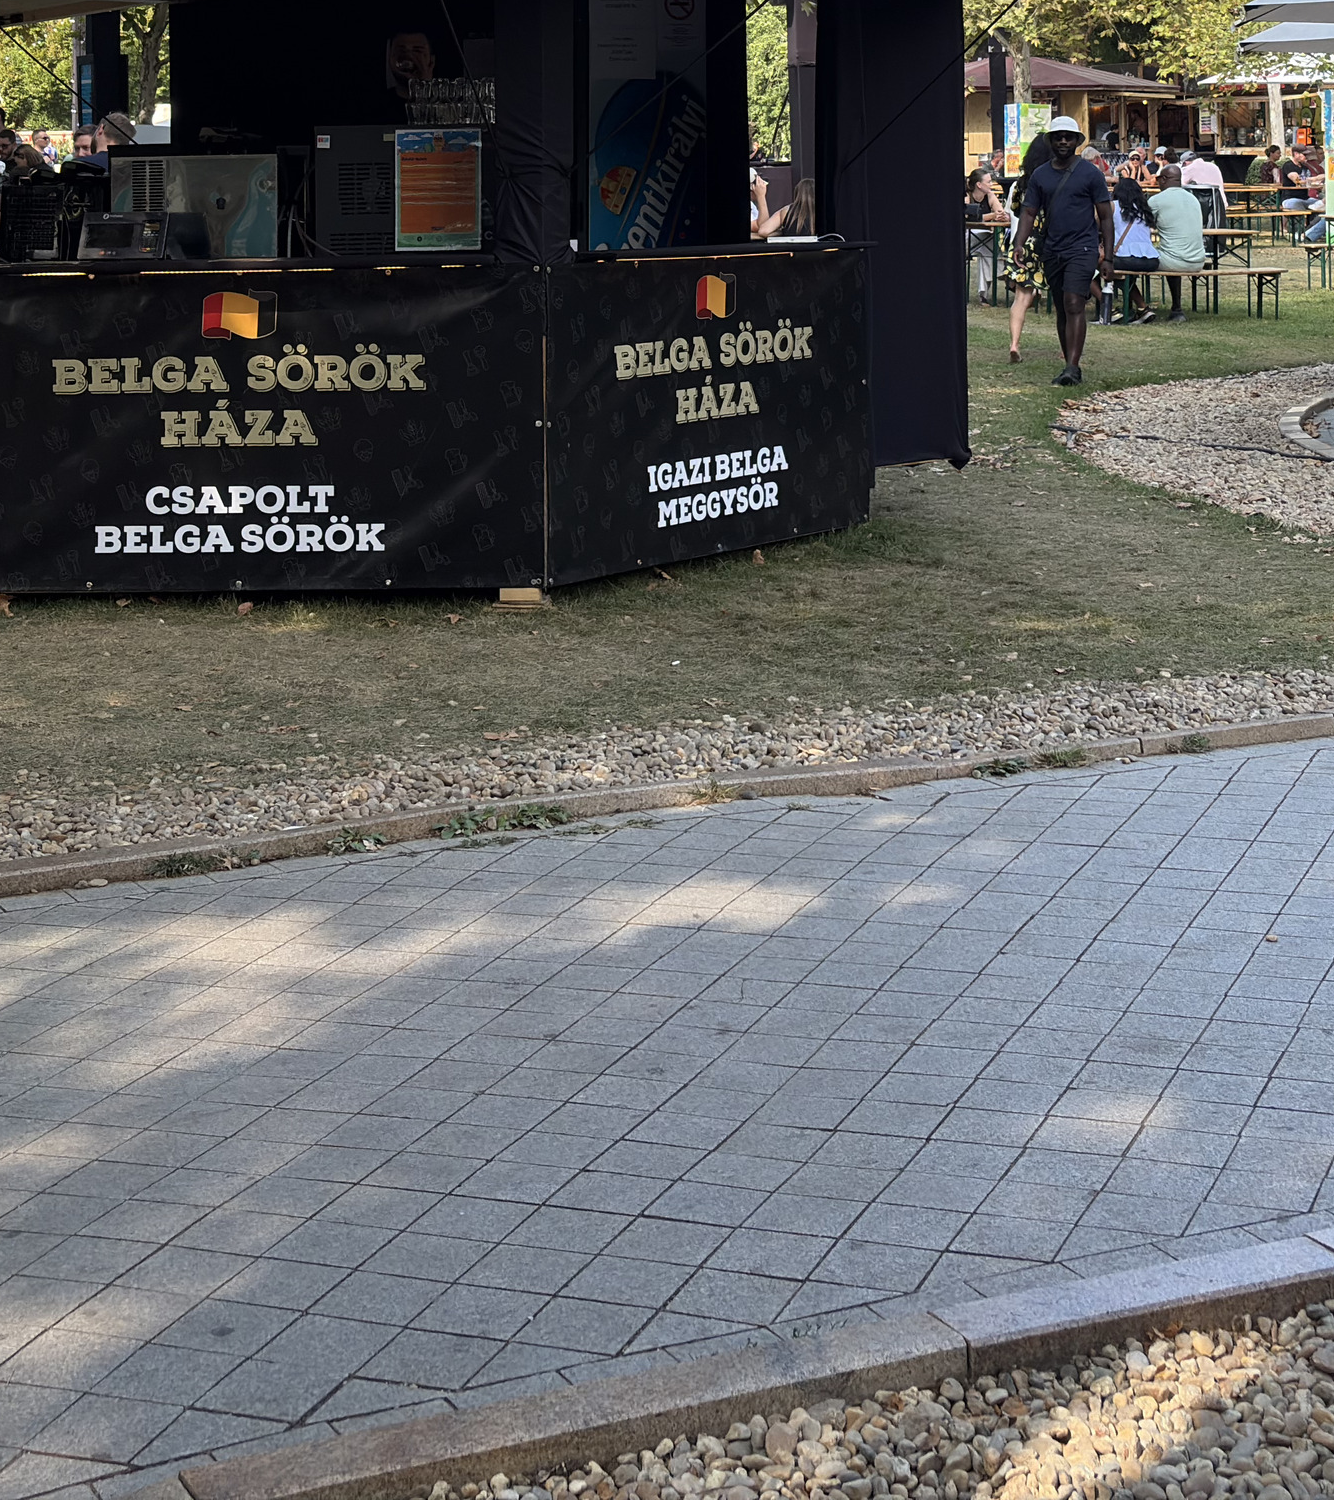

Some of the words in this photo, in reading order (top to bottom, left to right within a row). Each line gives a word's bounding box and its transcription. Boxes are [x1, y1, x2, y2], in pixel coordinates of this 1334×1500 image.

[51, 354, 230, 396] BELGA
[246, 343, 427, 393] SÖRÖK
[613, 335, 713, 381] BELGA
[719, 318, 815, 367] SÖRÖK
[160, 399, 319, 449] HÁZA
[675, 375, 760, 425] HÁZA
[646, 454, 712, 494] IGAZI
[714, 445, 789, 482] BELGA
[145, 484, 335, 516] CSAPOLT
[656, 476, 779, 529] MEGGYSÖR
[94, 523, 235, 555] BELGA
[238, 514, 386, 553] SÖRÖK
